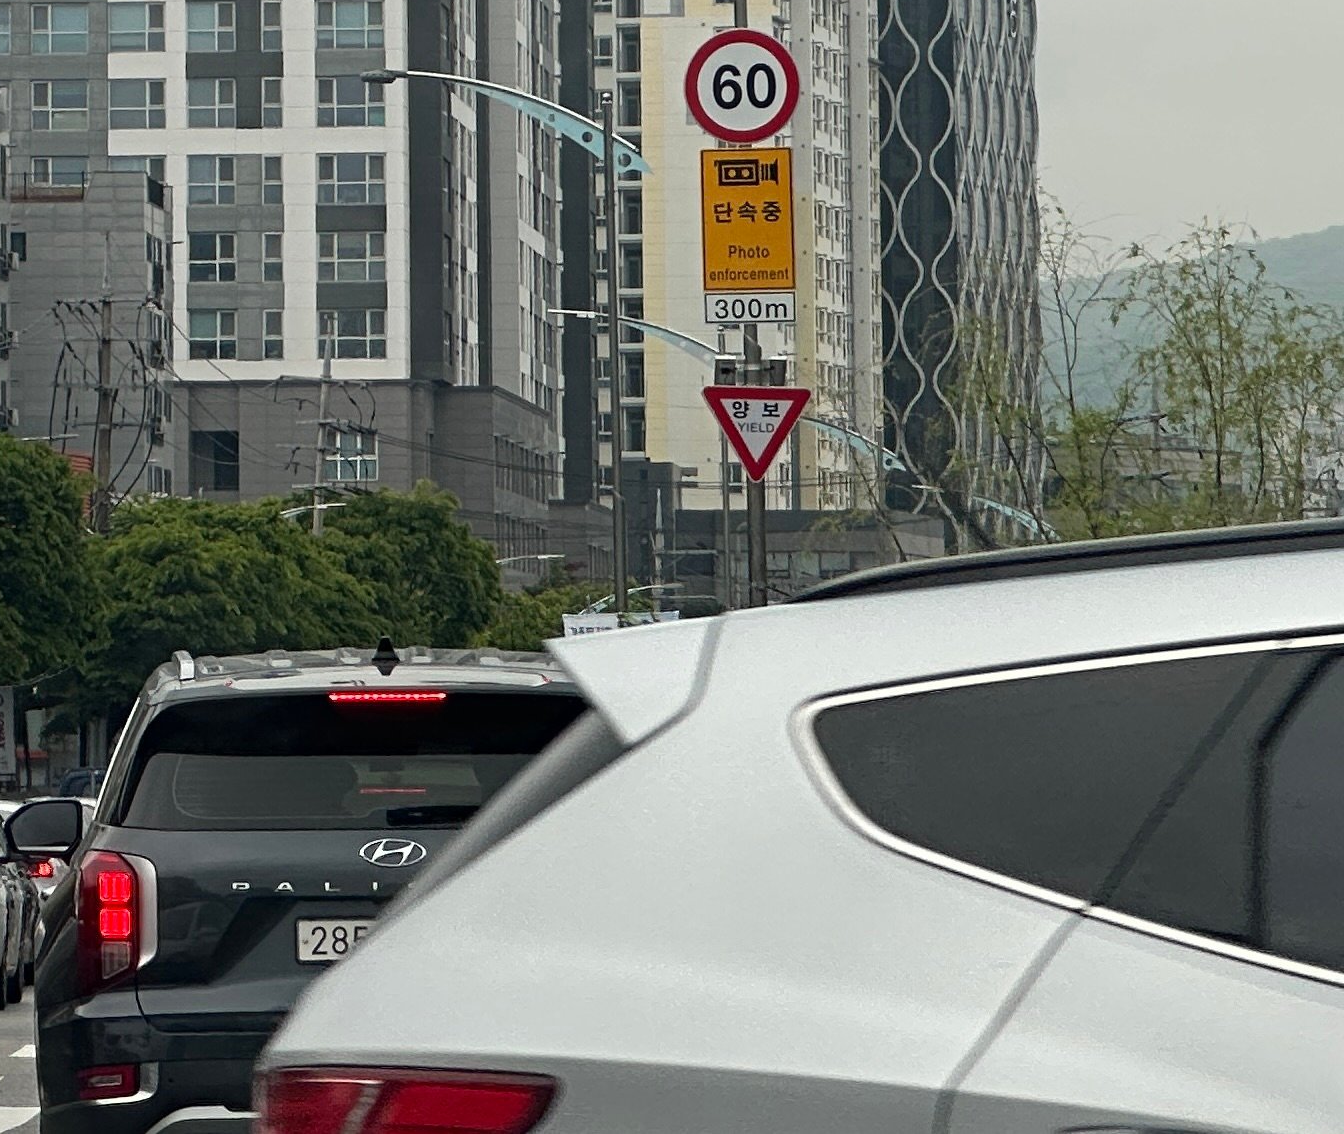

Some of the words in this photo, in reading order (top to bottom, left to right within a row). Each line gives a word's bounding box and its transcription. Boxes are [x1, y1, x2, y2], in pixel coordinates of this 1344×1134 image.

[712, 63, 776, 110] 60
[713, 201, 782, 223] 단속중
[728, 244, 770, 259] Photo
[709, 266, 789, 282] enforcement
[714, 298, 788, 319] 300m
[739, 422, 775, 434] YIELD
[232, 881, 379, 893] PALI
